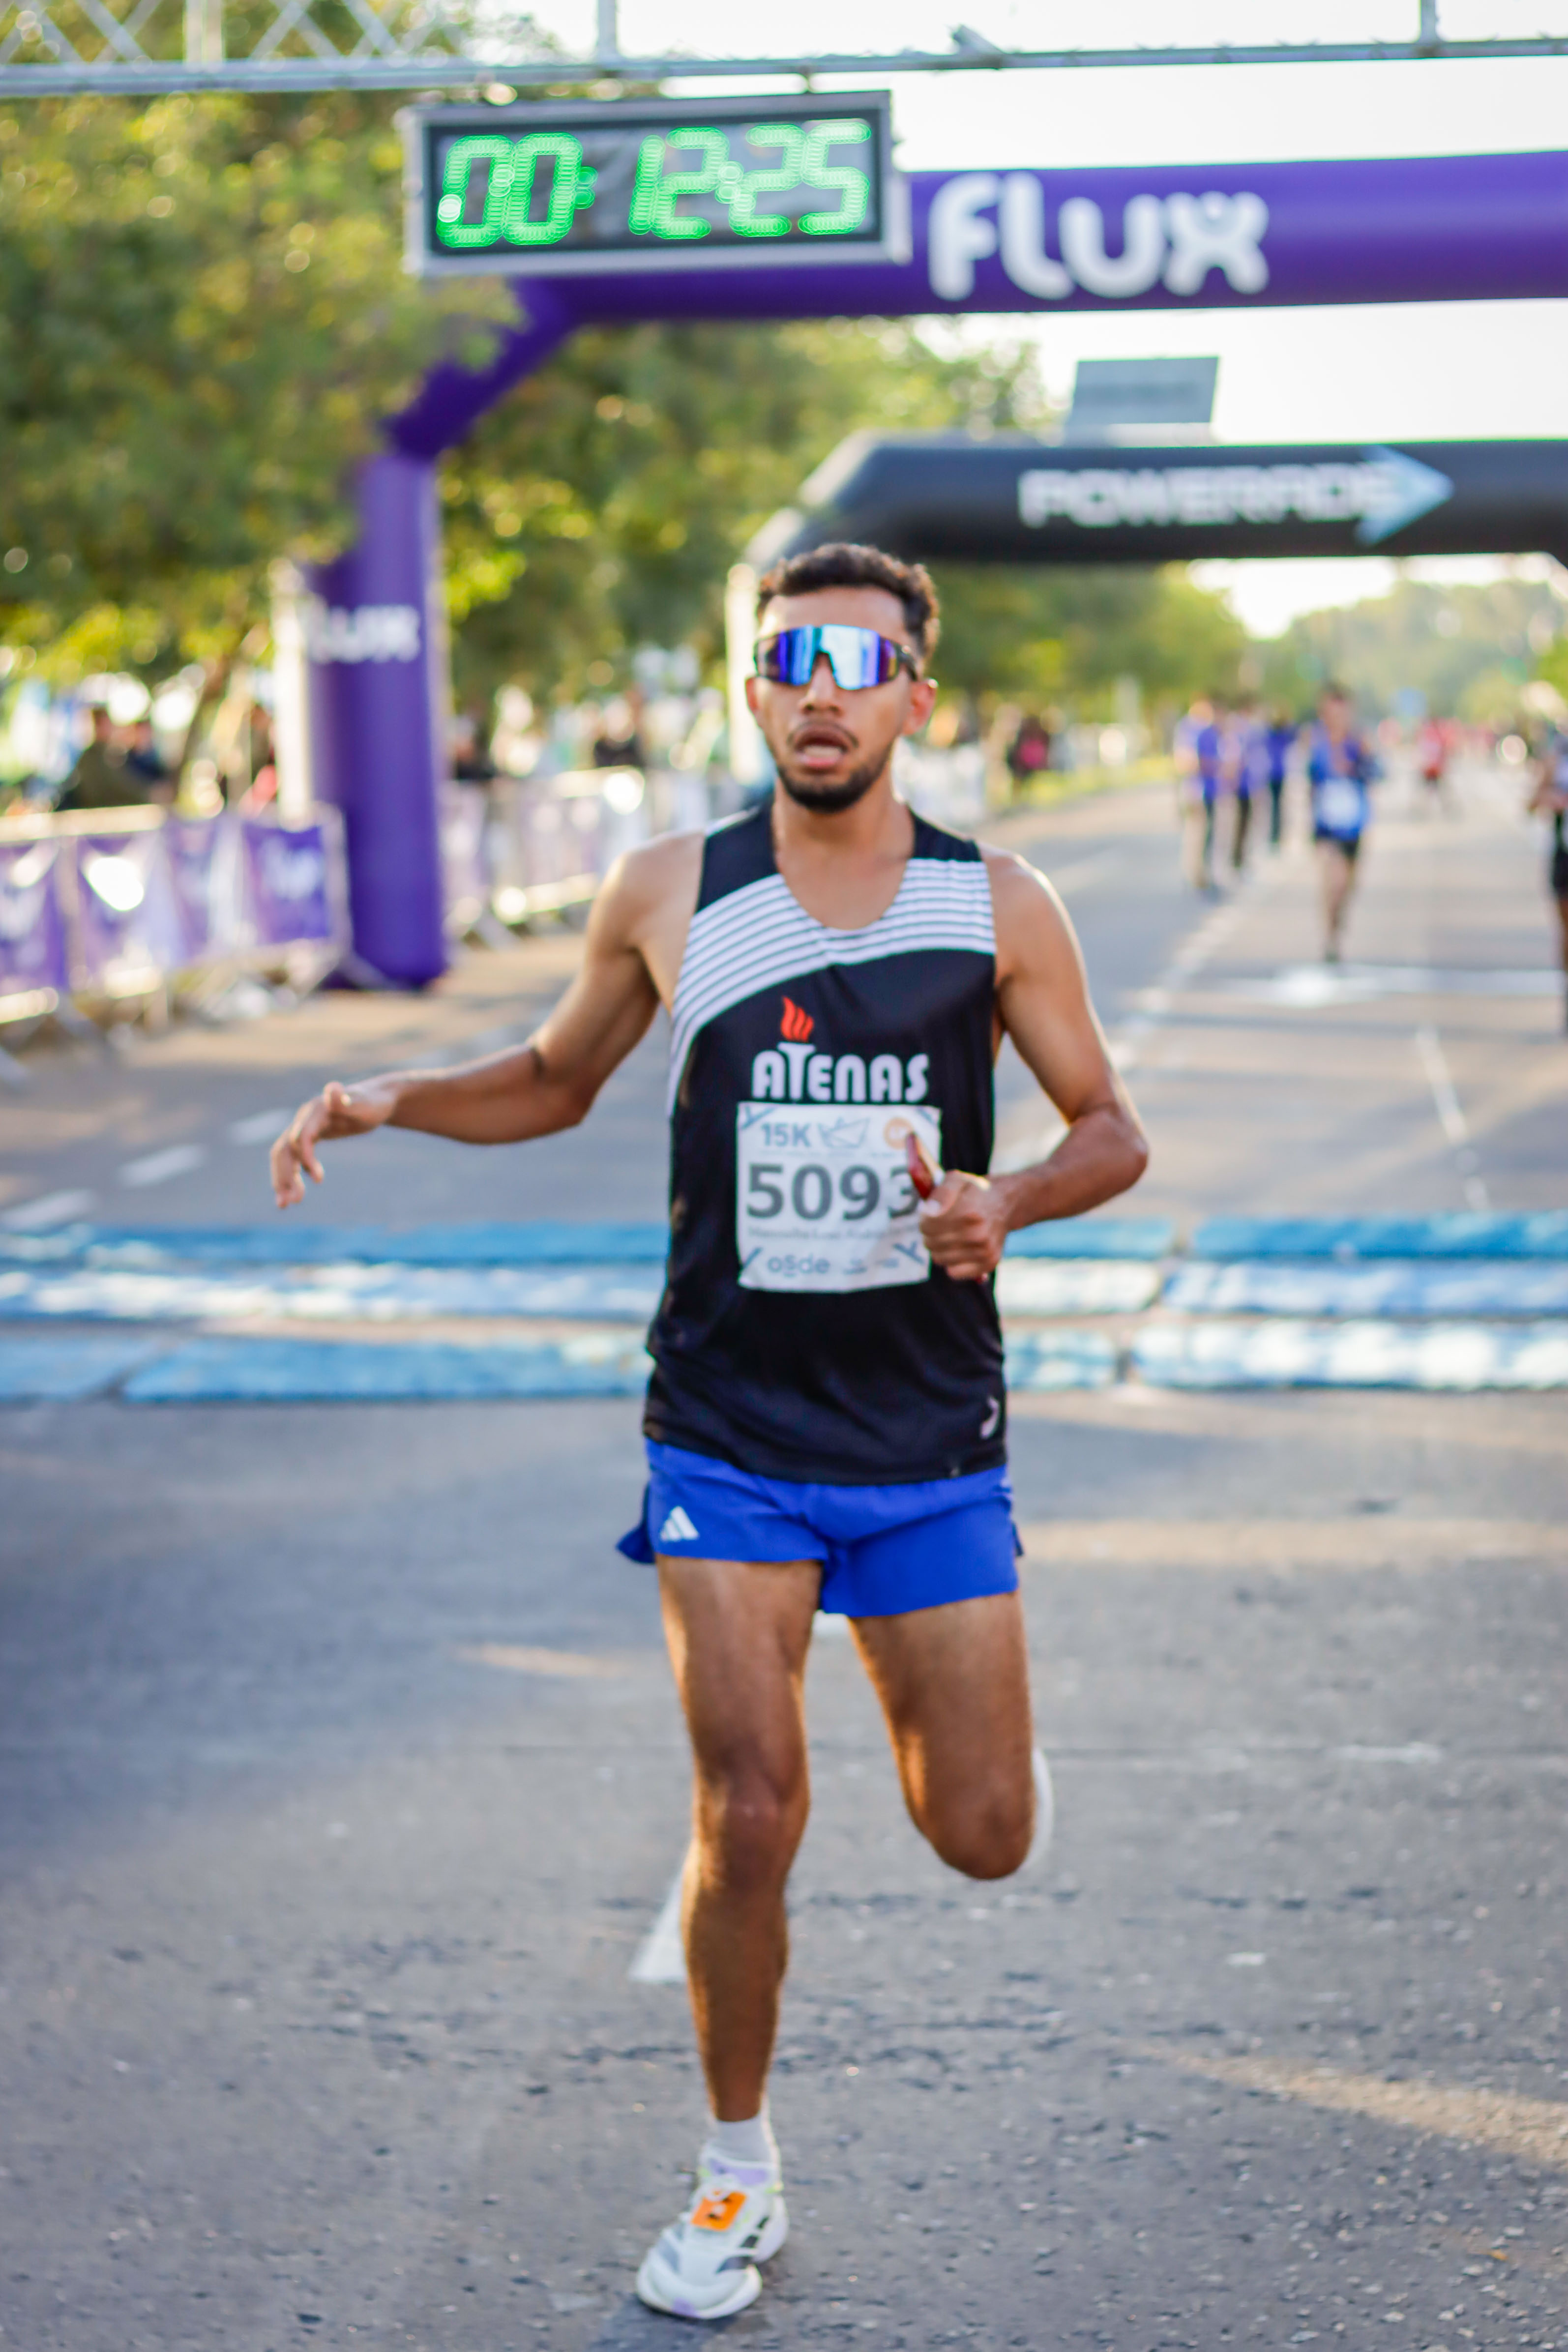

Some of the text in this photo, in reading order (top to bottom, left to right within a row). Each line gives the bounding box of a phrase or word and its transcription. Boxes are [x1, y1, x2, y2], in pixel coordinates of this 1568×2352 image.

[751, 1041, 929, 1104] ATENAS
[761, 1121, 811, 1148] 15K
[746, 1162, 919, 1221] 5093
